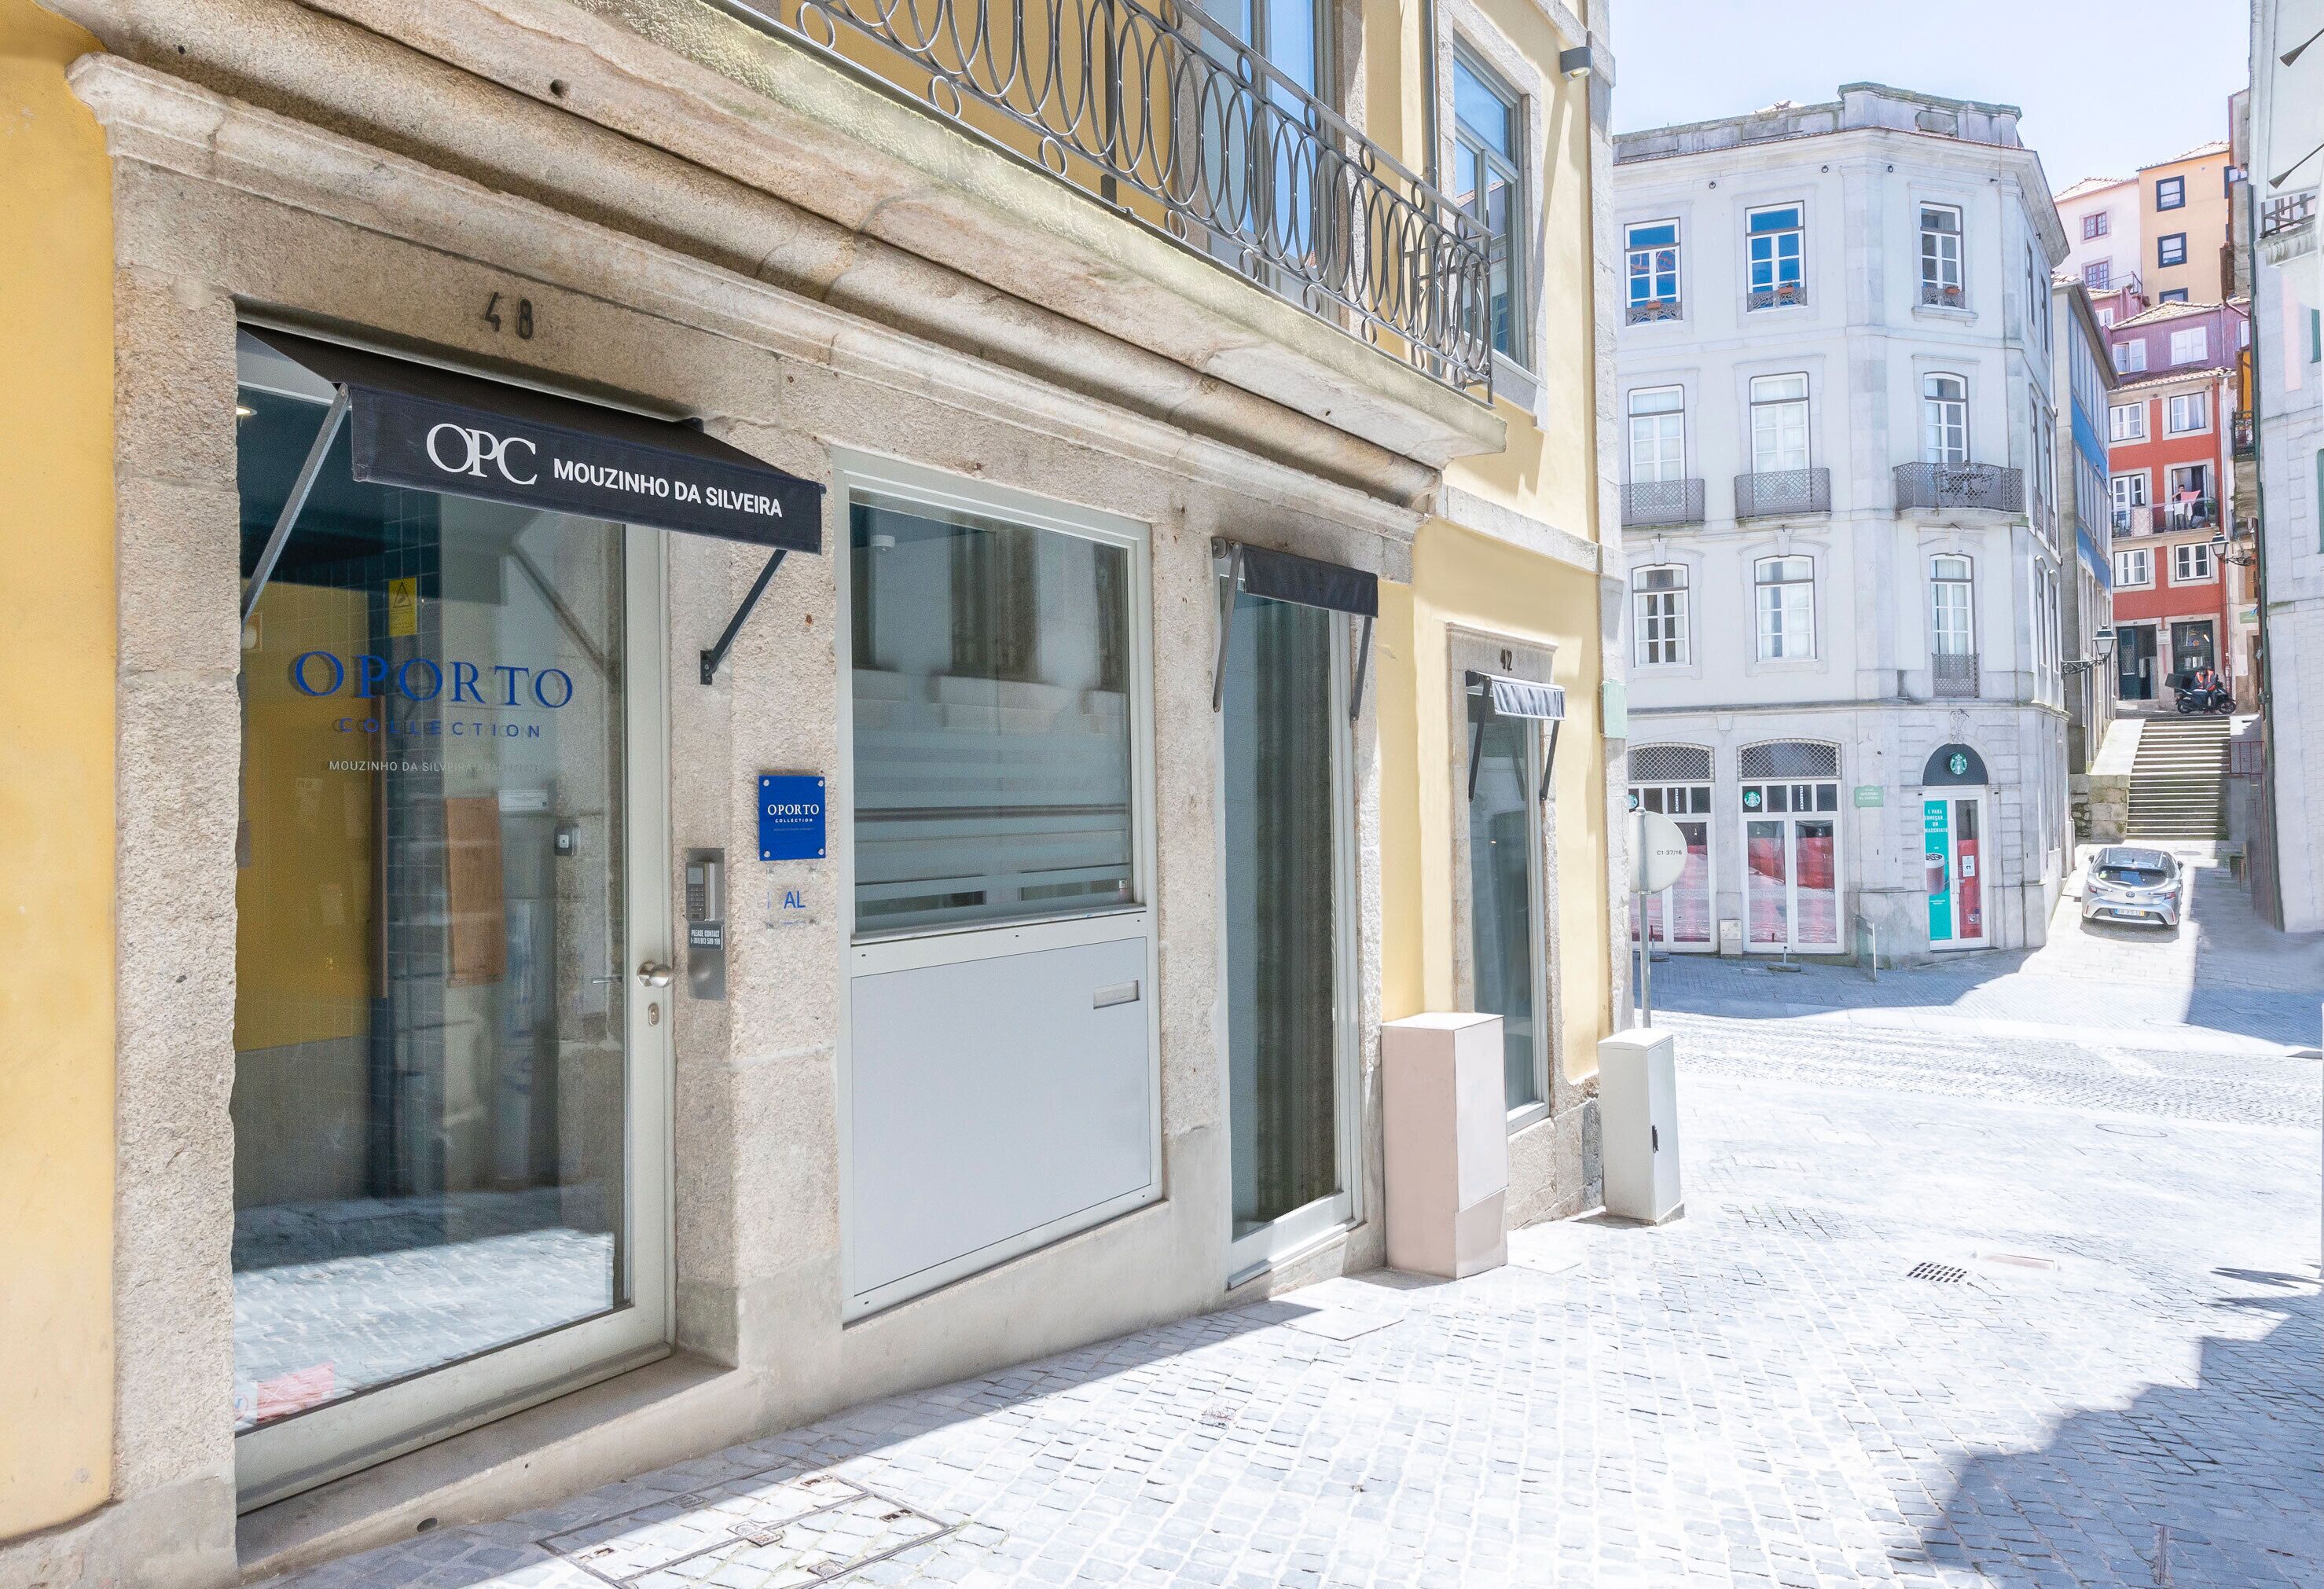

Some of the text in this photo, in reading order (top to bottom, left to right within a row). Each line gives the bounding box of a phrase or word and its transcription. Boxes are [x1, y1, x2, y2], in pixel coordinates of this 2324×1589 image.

[483, 292, 534, 339] 48
[426, 423, 783, 517] OPC MOUZINHO DA SILVEIRA
[295, 651, 573, 708] OPORTO
[340, 717, 540, 738] COLLECTION
[329, 761, 398, 771] MOUZINHO
[402, 761, 418, 772] DA
[767, 804, 820, 816] OPORTO
[784, 890, 806, 909] AL
